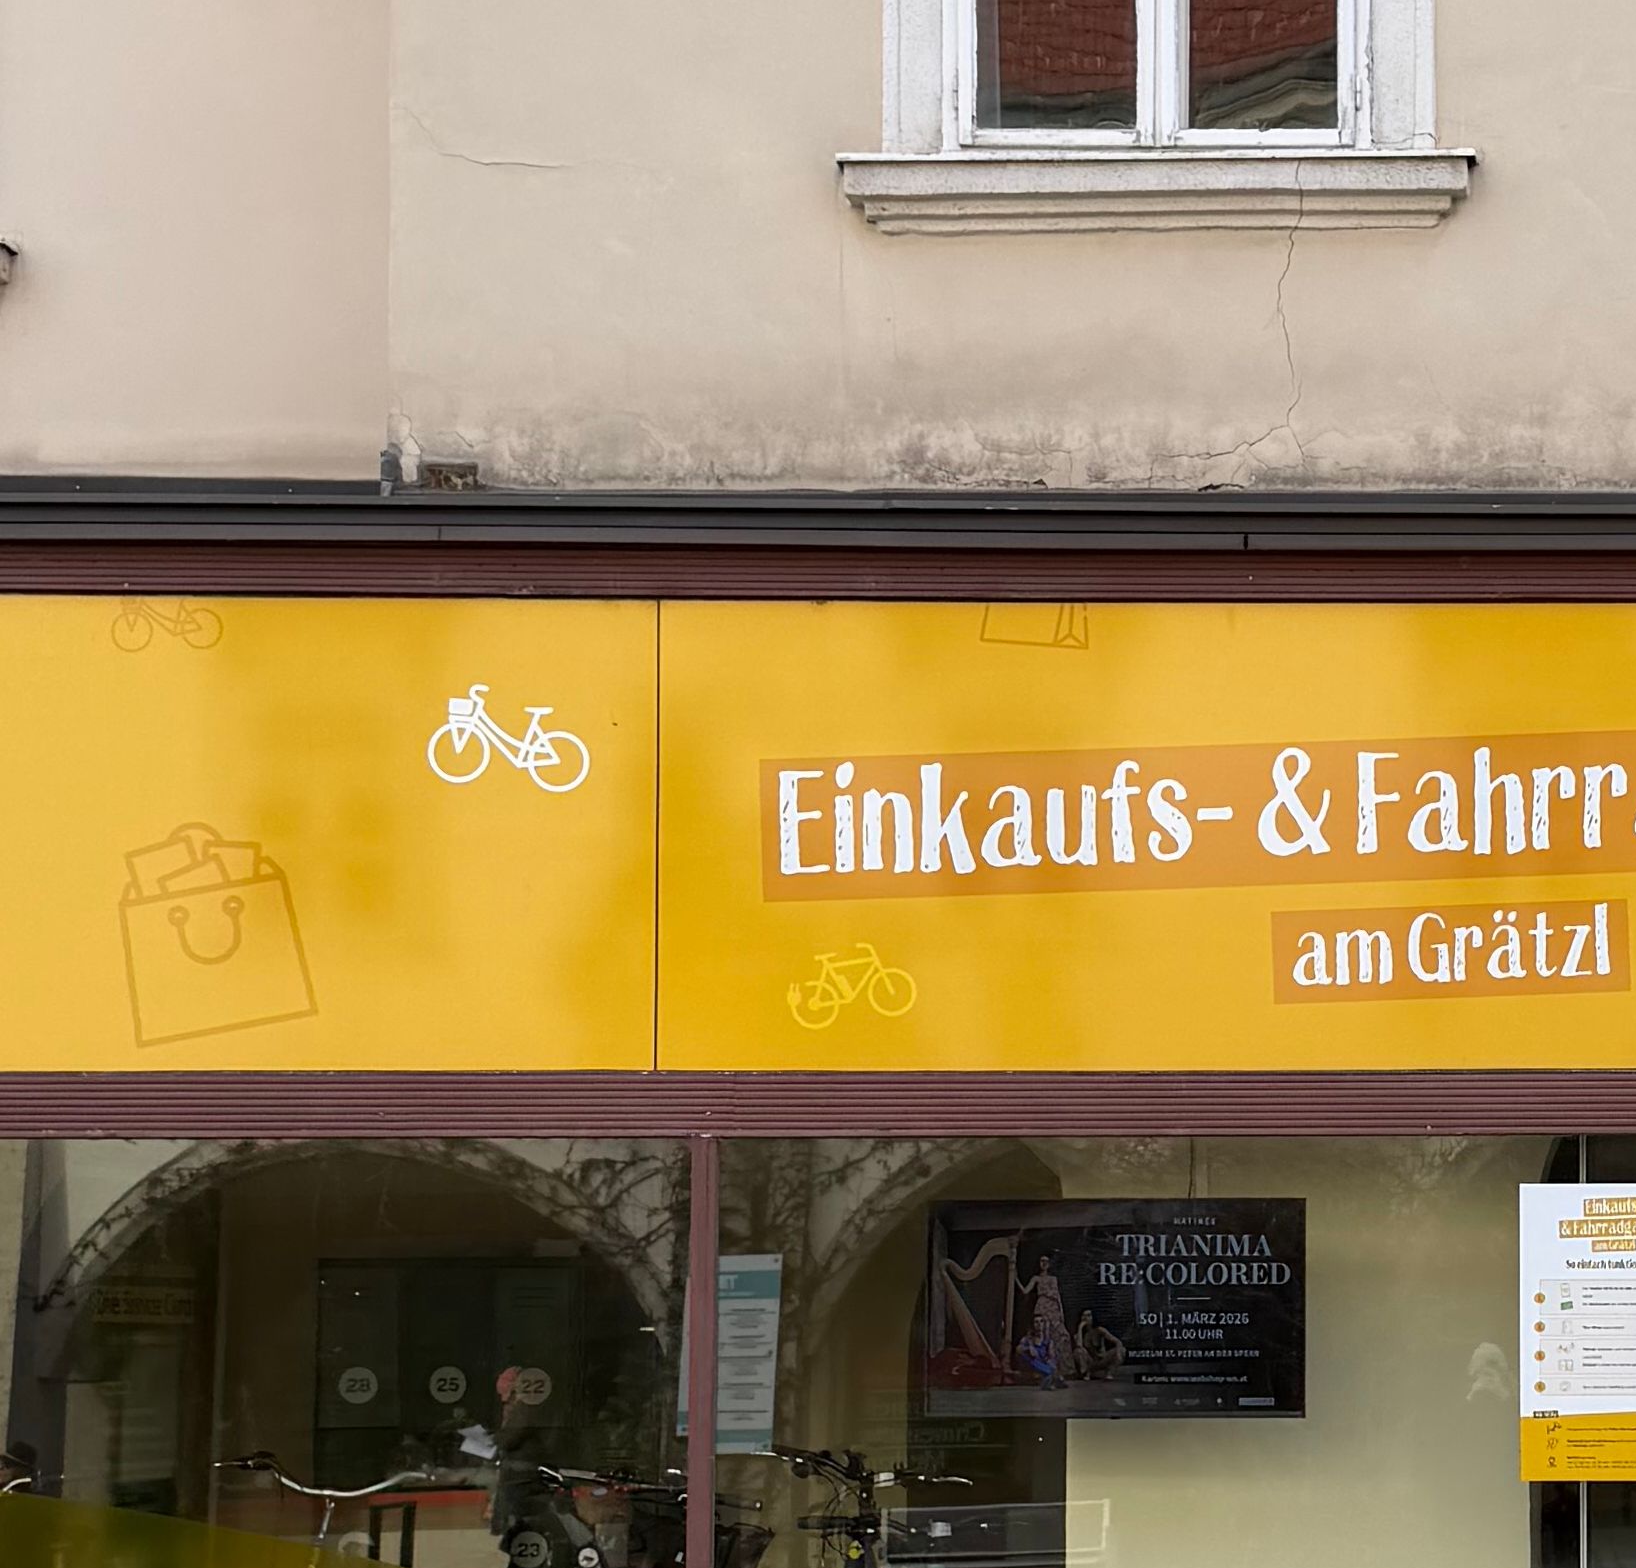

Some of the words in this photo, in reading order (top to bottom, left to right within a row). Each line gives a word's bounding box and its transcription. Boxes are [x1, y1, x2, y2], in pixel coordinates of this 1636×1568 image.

[777, 761, 1233, 876] Einkaufs-
[1257, 746, 1330, 857] &
[1291, 928, 1393, 987] am
[1407, 902, 1611, 984] Grätzl
[1560, 1222, 1571, 1237] &
[1115, 1234, 1273, 1258] TRIANIMA
[1097, 1262, 1292, 1286] RE:COLORED
[1139, 1312, 1158, 1325] SO
[1167, 1313, 1179, 1325] 1.
[1181, 1310, 1217, 1325] MÄRZ
[1219, 1312, 1250, 1326] 2026
[1164, 1328, 1197, 1341] 11.00
[1198, 1328, 1225, 1341] UHR
[436, 1376, 461, 1393] 25
[521, 1378, 545, 1394] 22
[516, 1542, 540, 1558] 23
